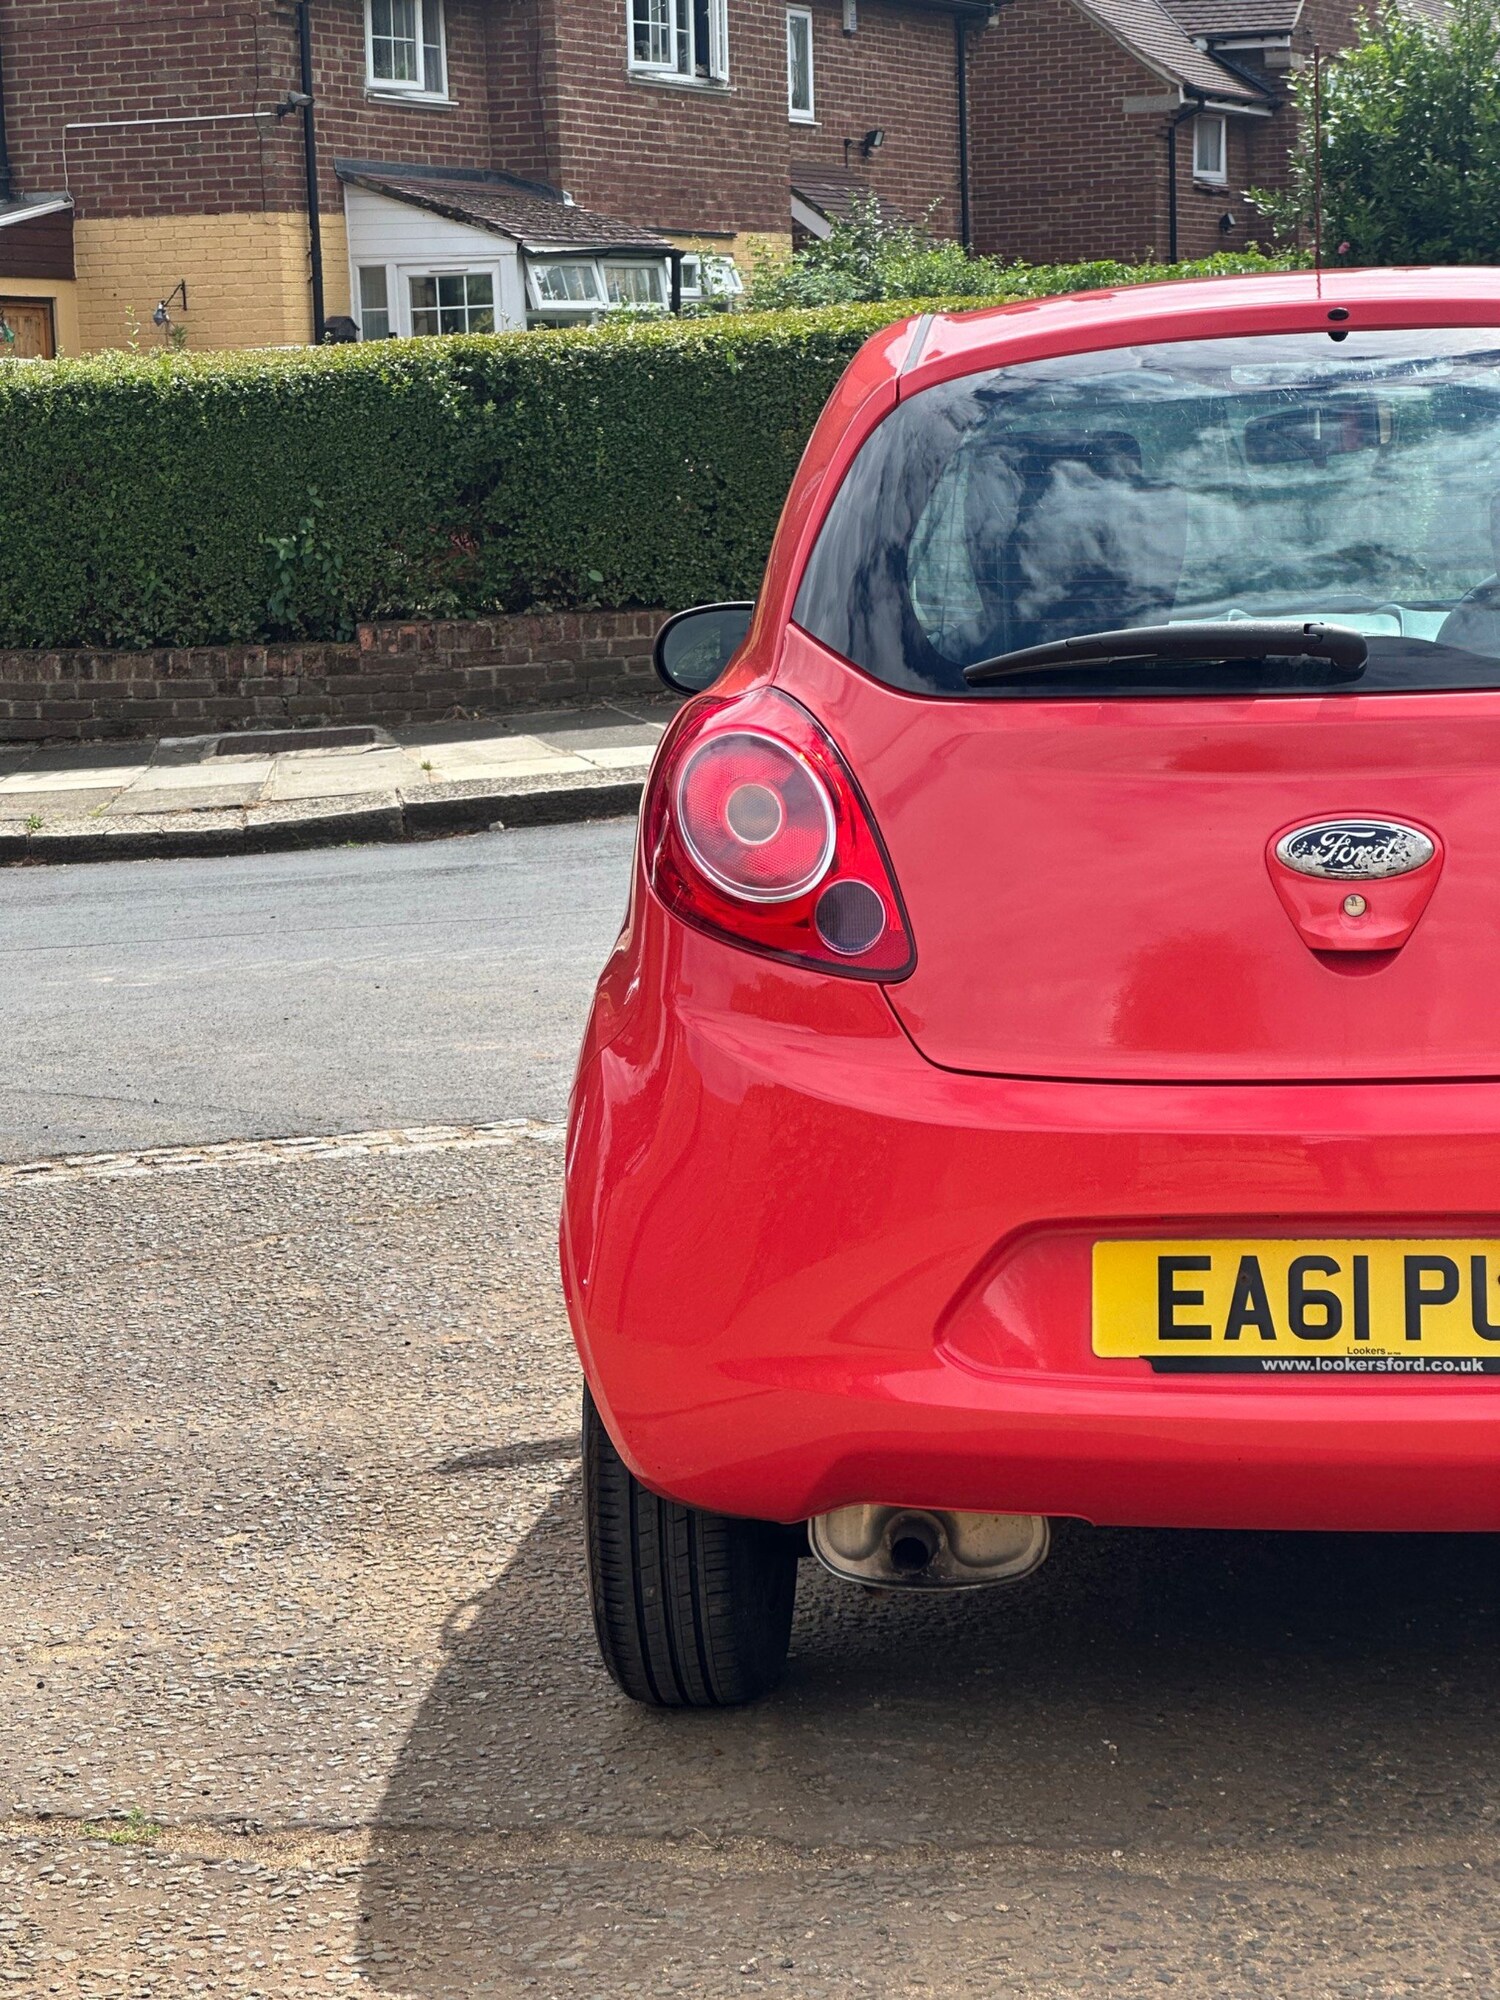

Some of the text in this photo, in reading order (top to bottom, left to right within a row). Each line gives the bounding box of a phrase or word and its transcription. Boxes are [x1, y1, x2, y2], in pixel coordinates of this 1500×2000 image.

[1316, 829, 1396, 864] Ford
[1158, 1255, 1370, 1341] EA61
[1347, 1346, 1386, 1355] Lookers
[1261, 1357, 1484, 1372] www.lookersford.co.uk
